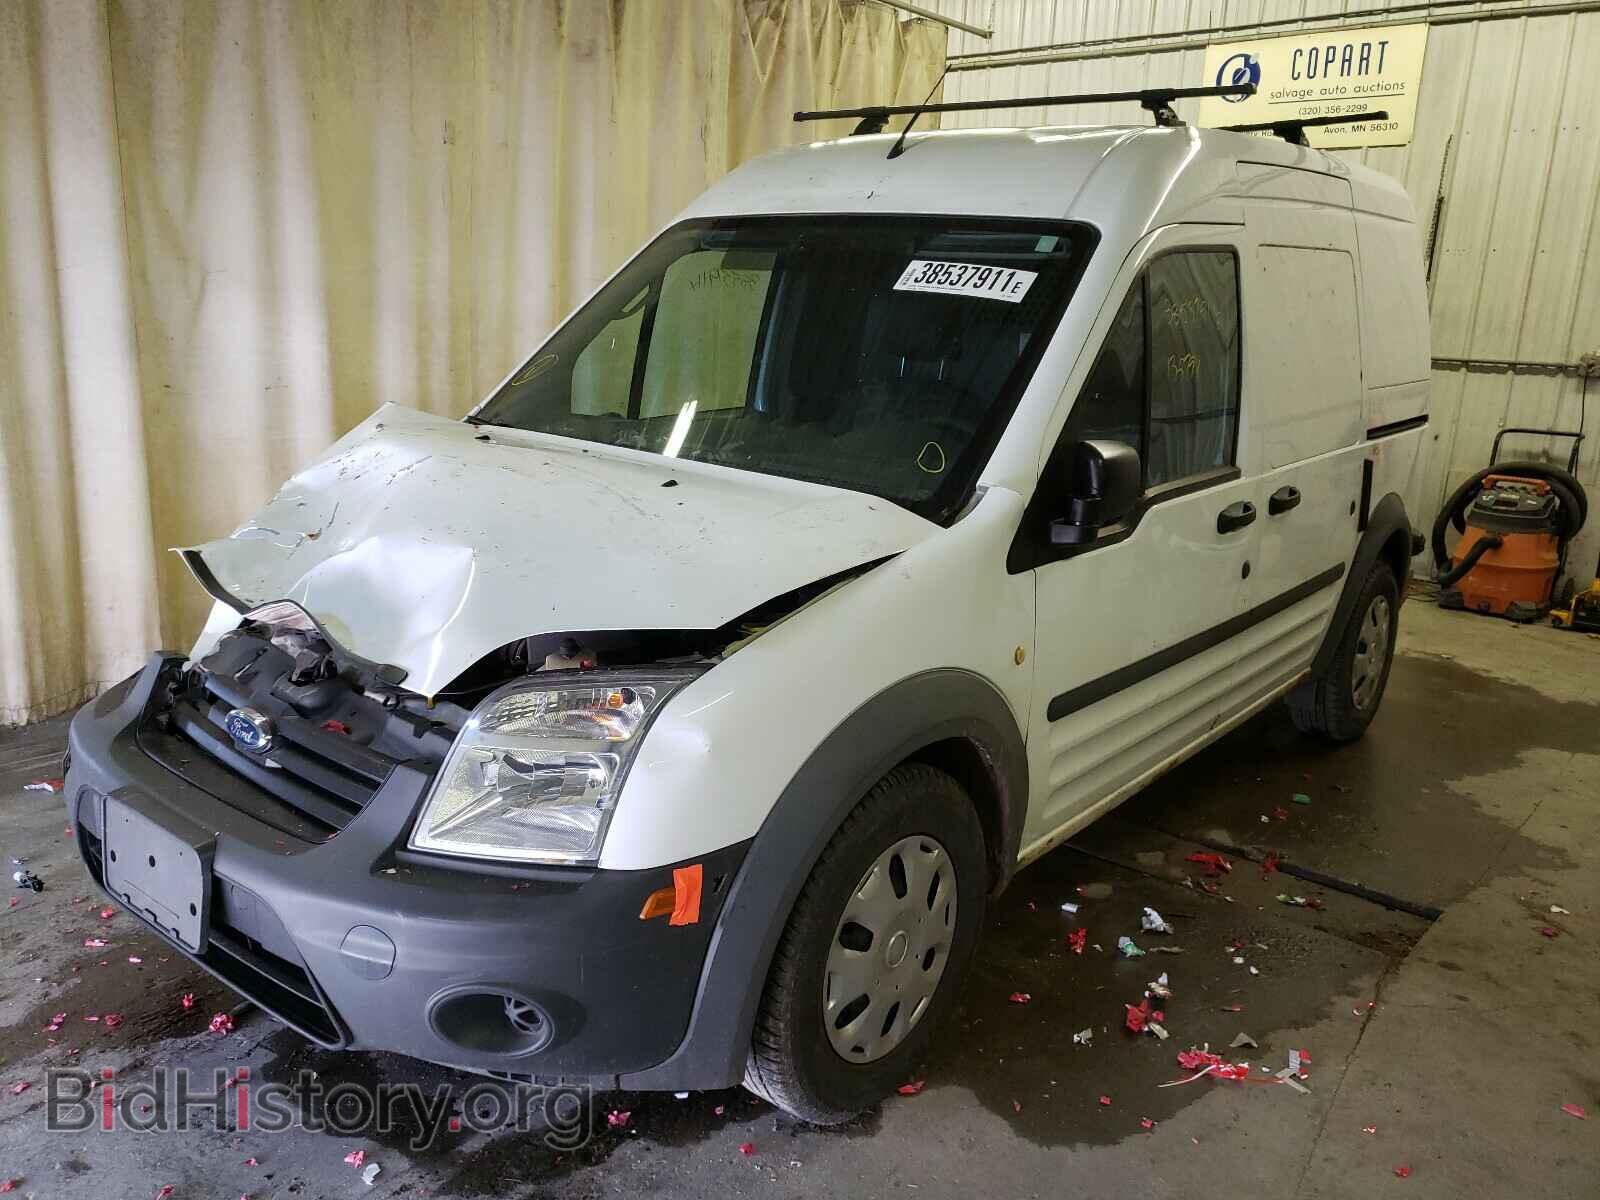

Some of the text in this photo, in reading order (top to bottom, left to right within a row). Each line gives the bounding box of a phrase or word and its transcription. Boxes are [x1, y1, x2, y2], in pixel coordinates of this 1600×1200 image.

[1291, 40, 1389, 81] COPART
[1269, 80, 1406, 99] salvage auto auctions
[1298, 103, 1368, 116] (320) 356-2299
[1351, 123, 1368, 133] MN
[1370, 121, 1399, 132] 56310
[231, 717, 254, 743] Ford
